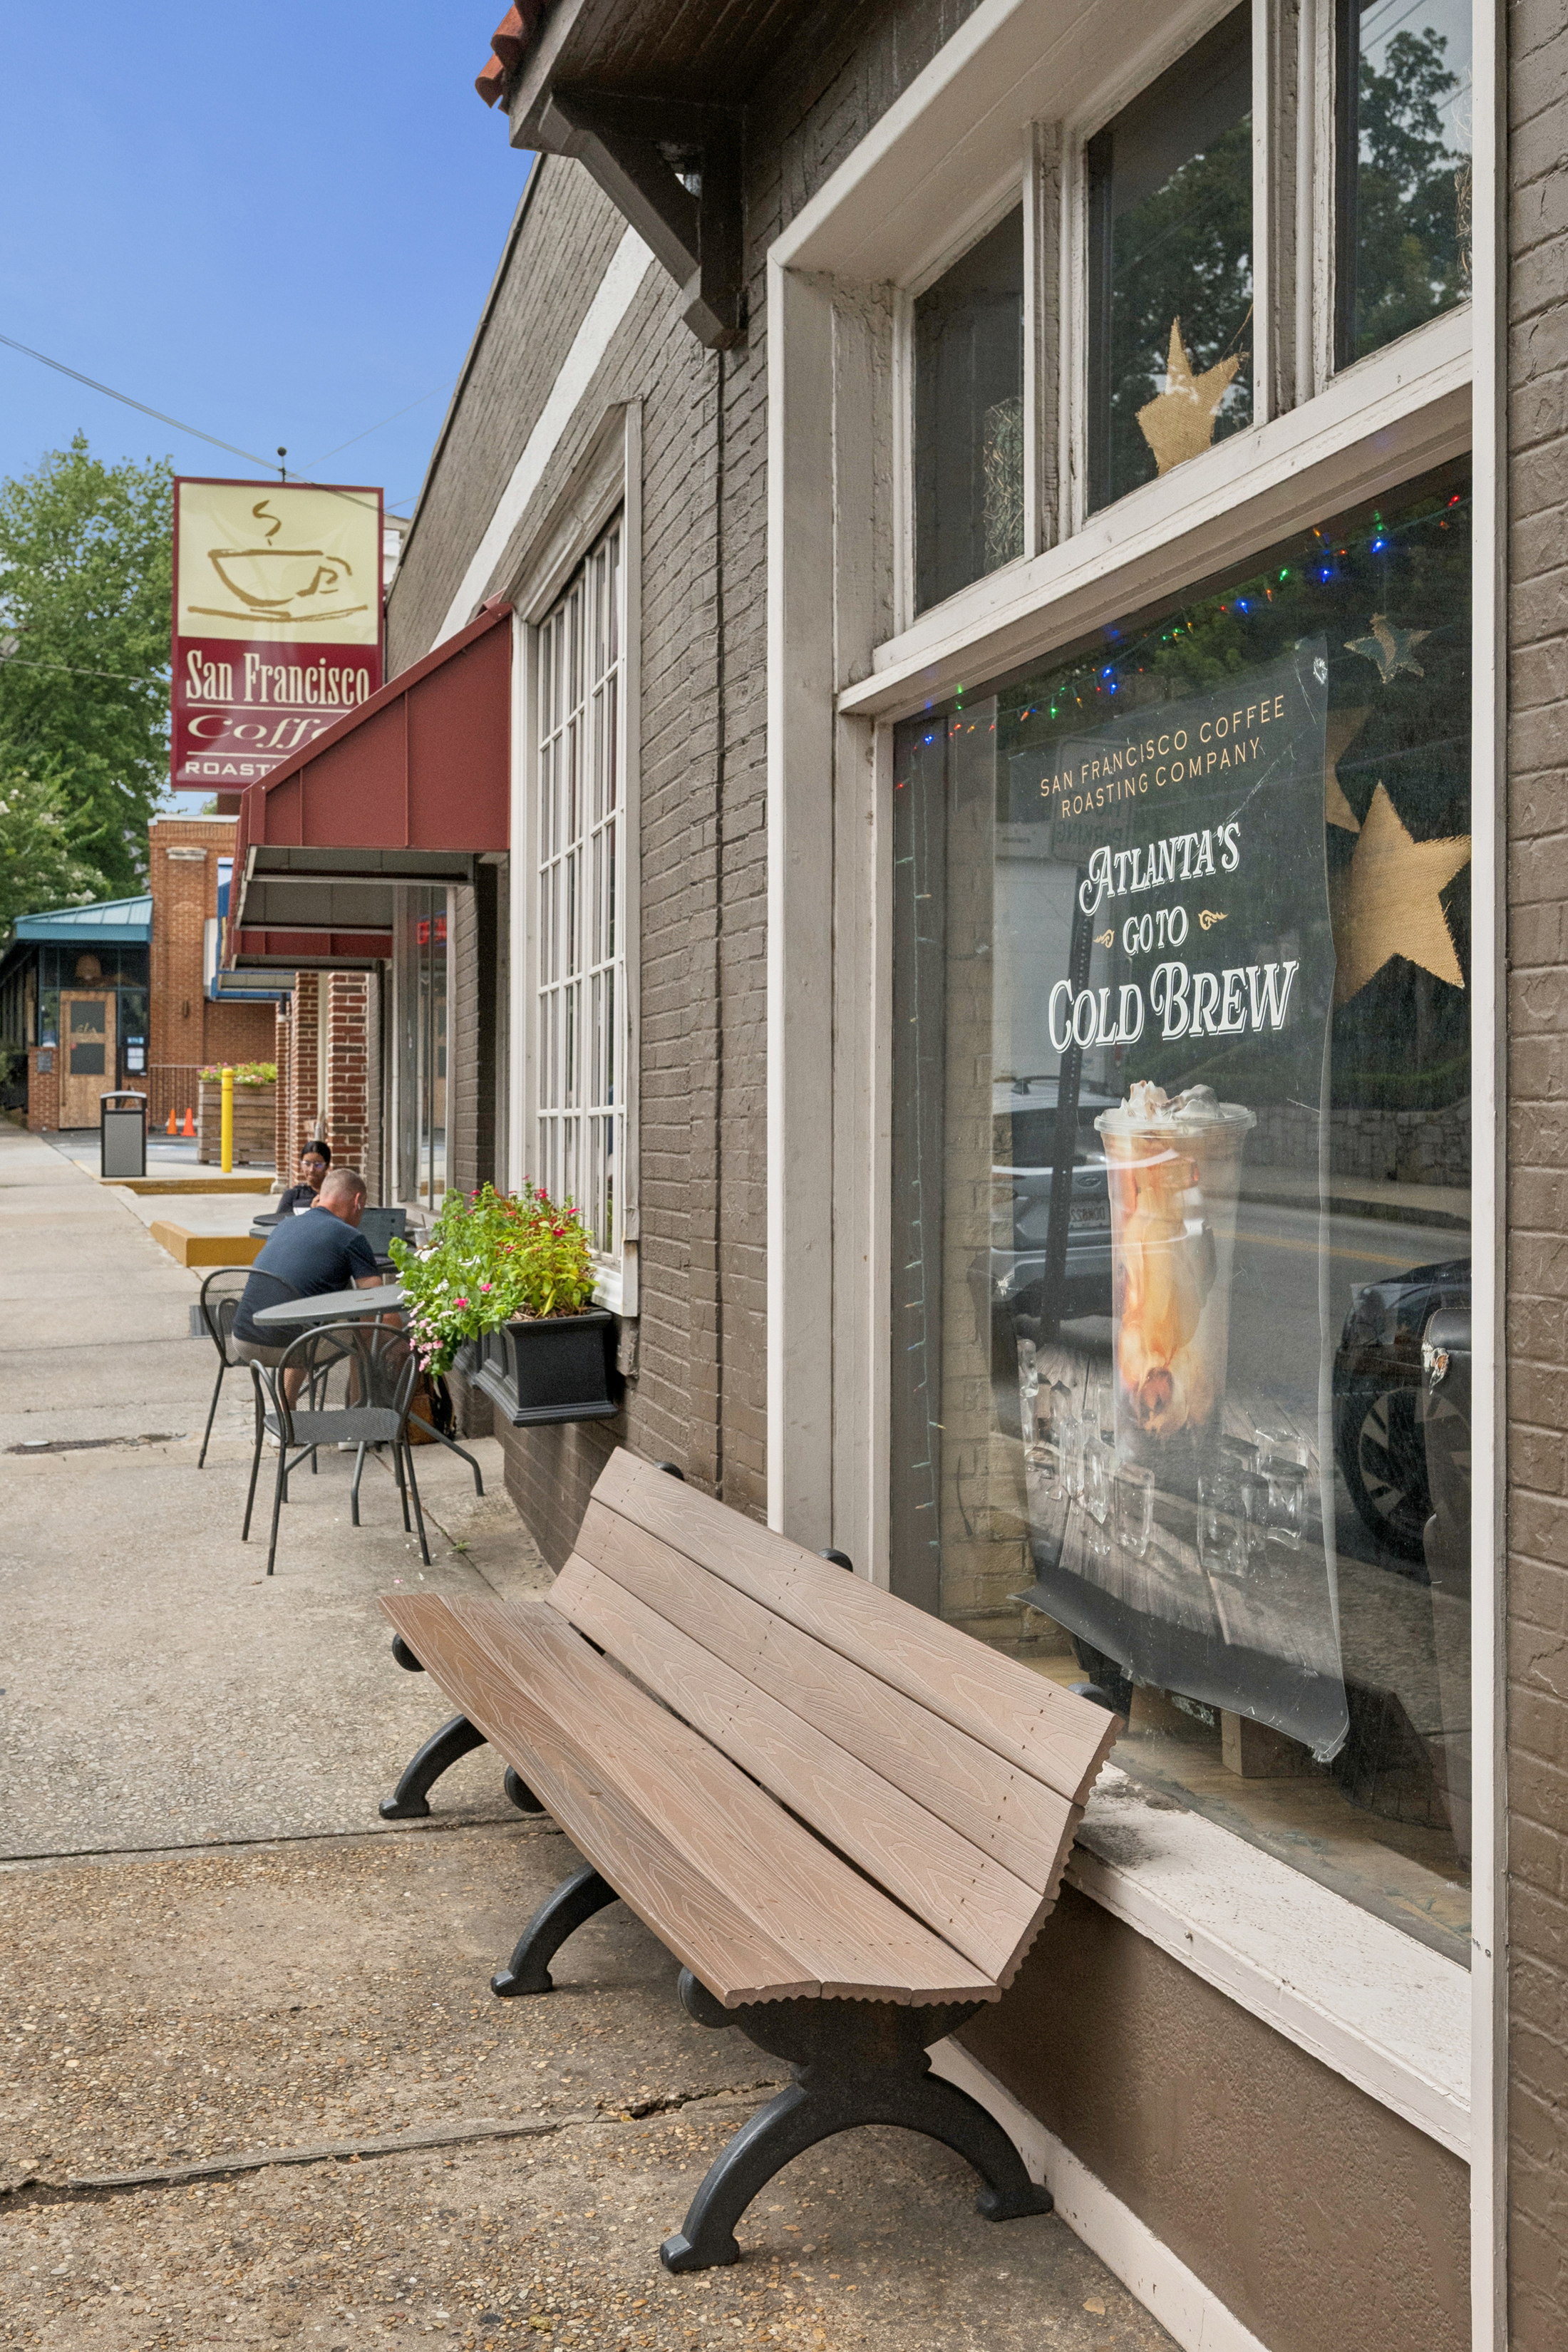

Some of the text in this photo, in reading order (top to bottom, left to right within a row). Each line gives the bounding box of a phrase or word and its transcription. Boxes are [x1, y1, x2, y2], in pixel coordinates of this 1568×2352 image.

[186, 649, 370, 706] San Francisco
[1040, 694, 1284, 797] SAN FRANCISCO COFFEE
[1061, 737, 1260, 818] ROASTING COMPANY
[1048, 961, 1299, 1053] COLD BREW
